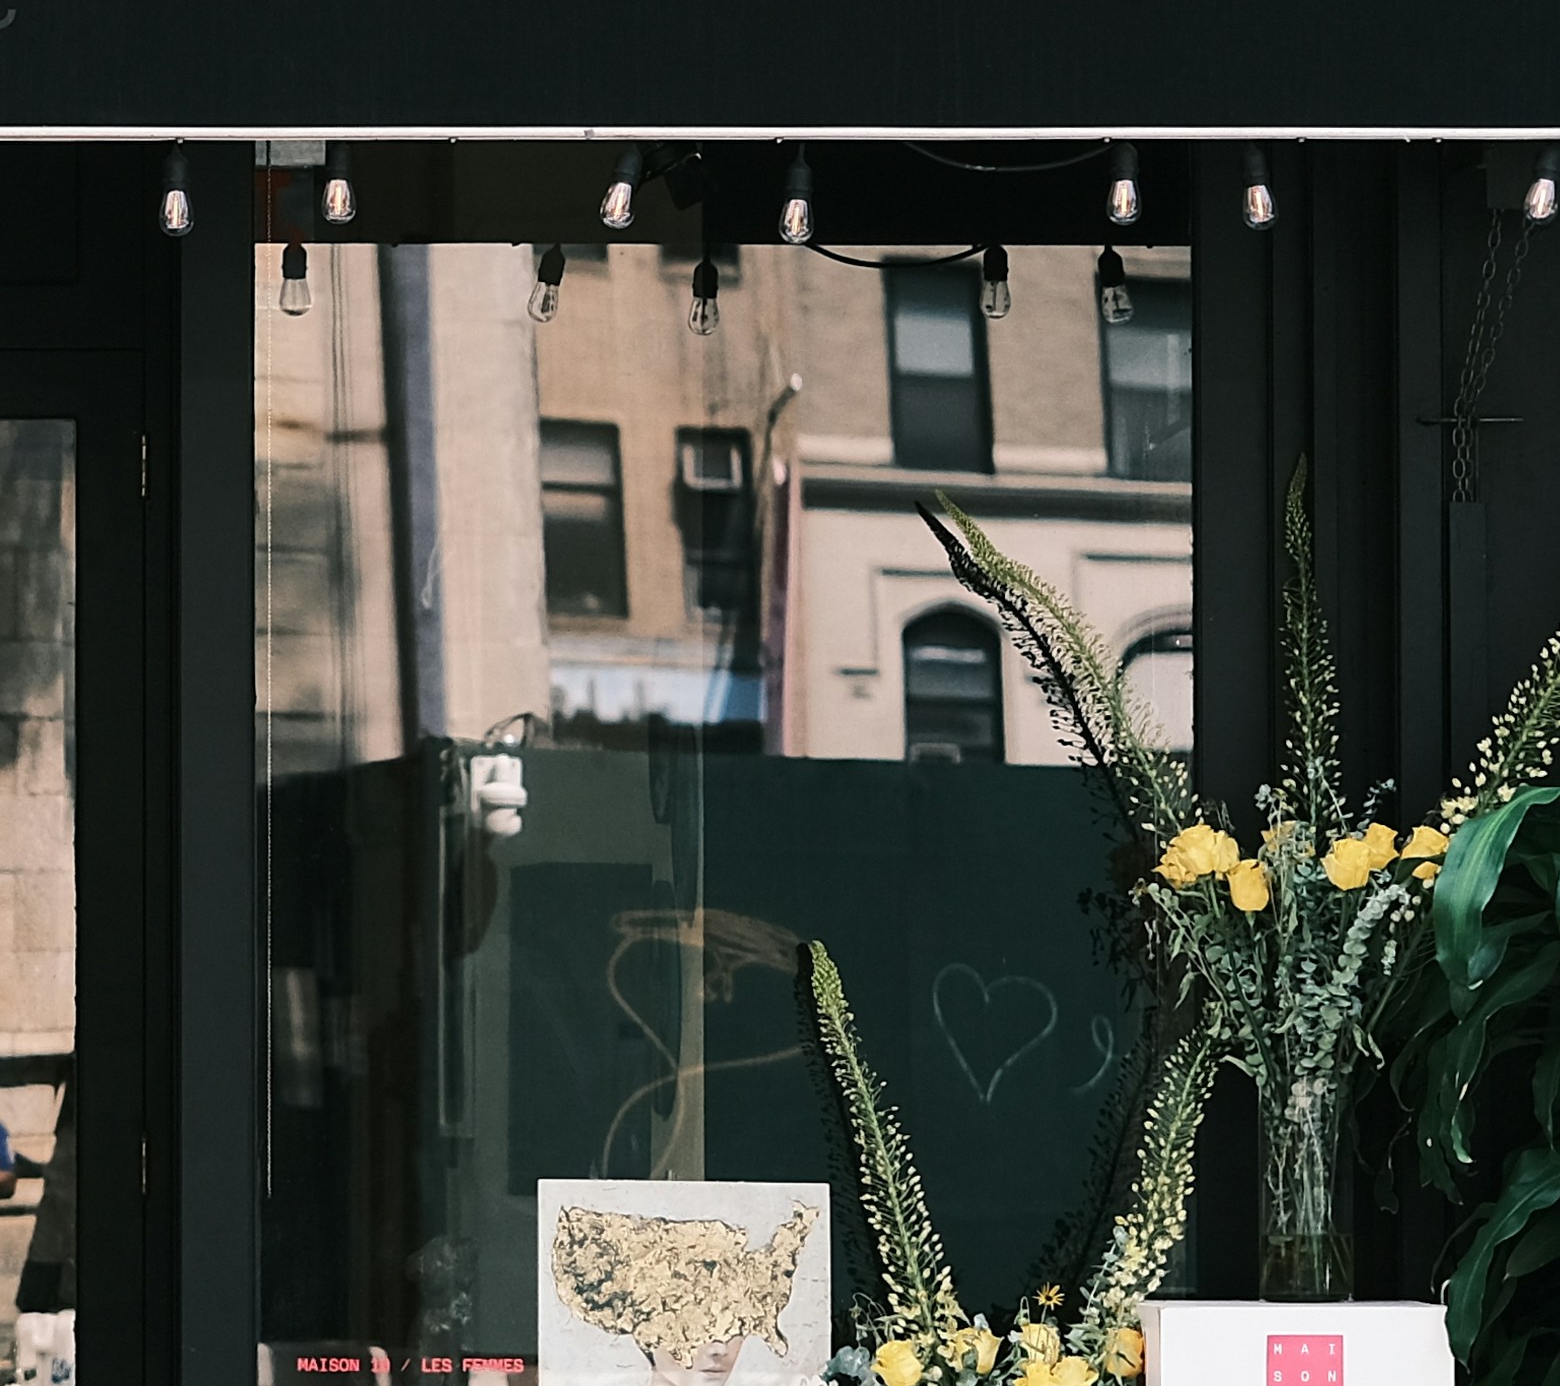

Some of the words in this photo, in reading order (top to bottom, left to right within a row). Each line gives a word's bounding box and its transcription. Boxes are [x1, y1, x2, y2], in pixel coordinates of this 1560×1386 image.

[297, 1357, 360, 1374] MAISON
[421, 1357, 453, 1374] LES
[461, 1357, 525, 1374] FEMMES
